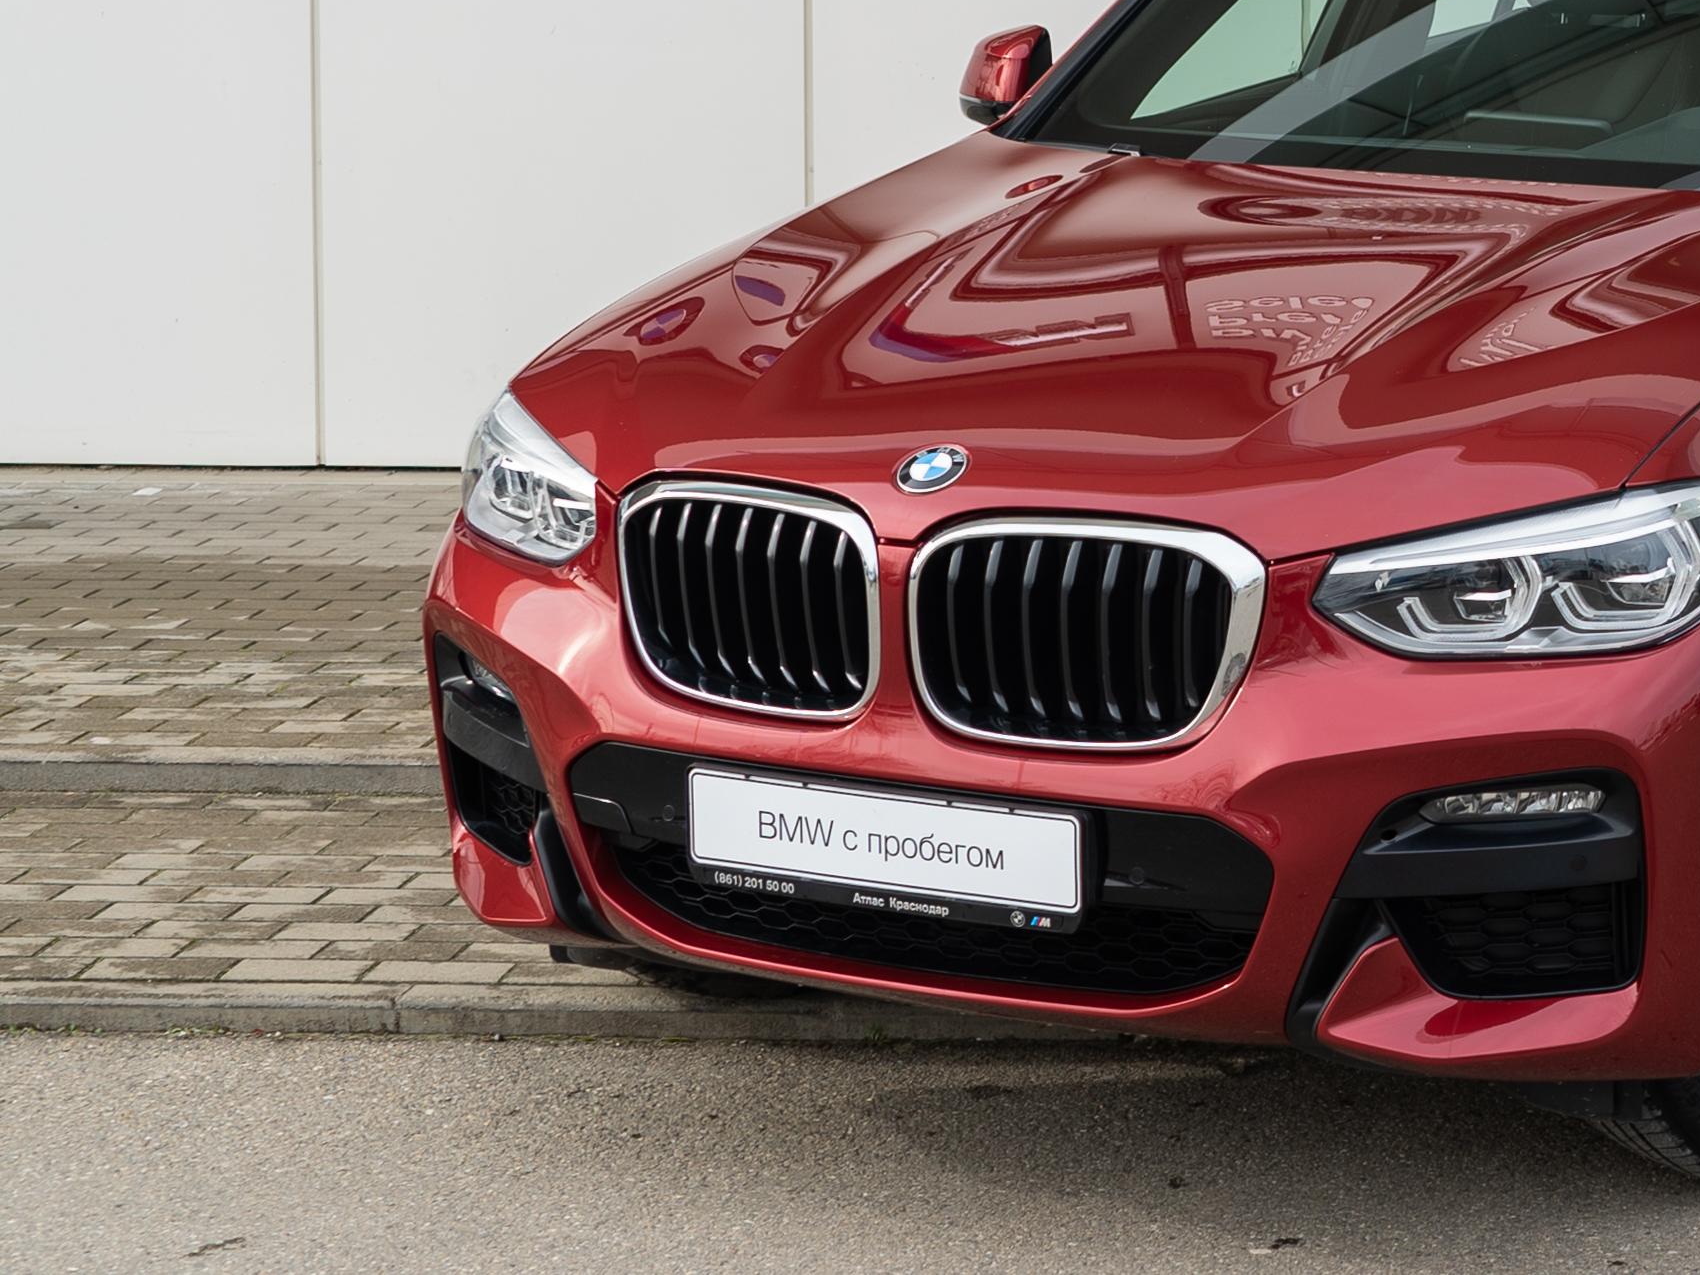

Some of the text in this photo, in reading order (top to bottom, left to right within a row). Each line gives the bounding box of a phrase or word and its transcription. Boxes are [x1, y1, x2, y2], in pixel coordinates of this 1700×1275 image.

[757, 810, 1005, 871] BMW с пробегом
[714, 870, 796, 894] (861) 201 50 00
[853, 892, 950, 918] Атлас Краснодар
